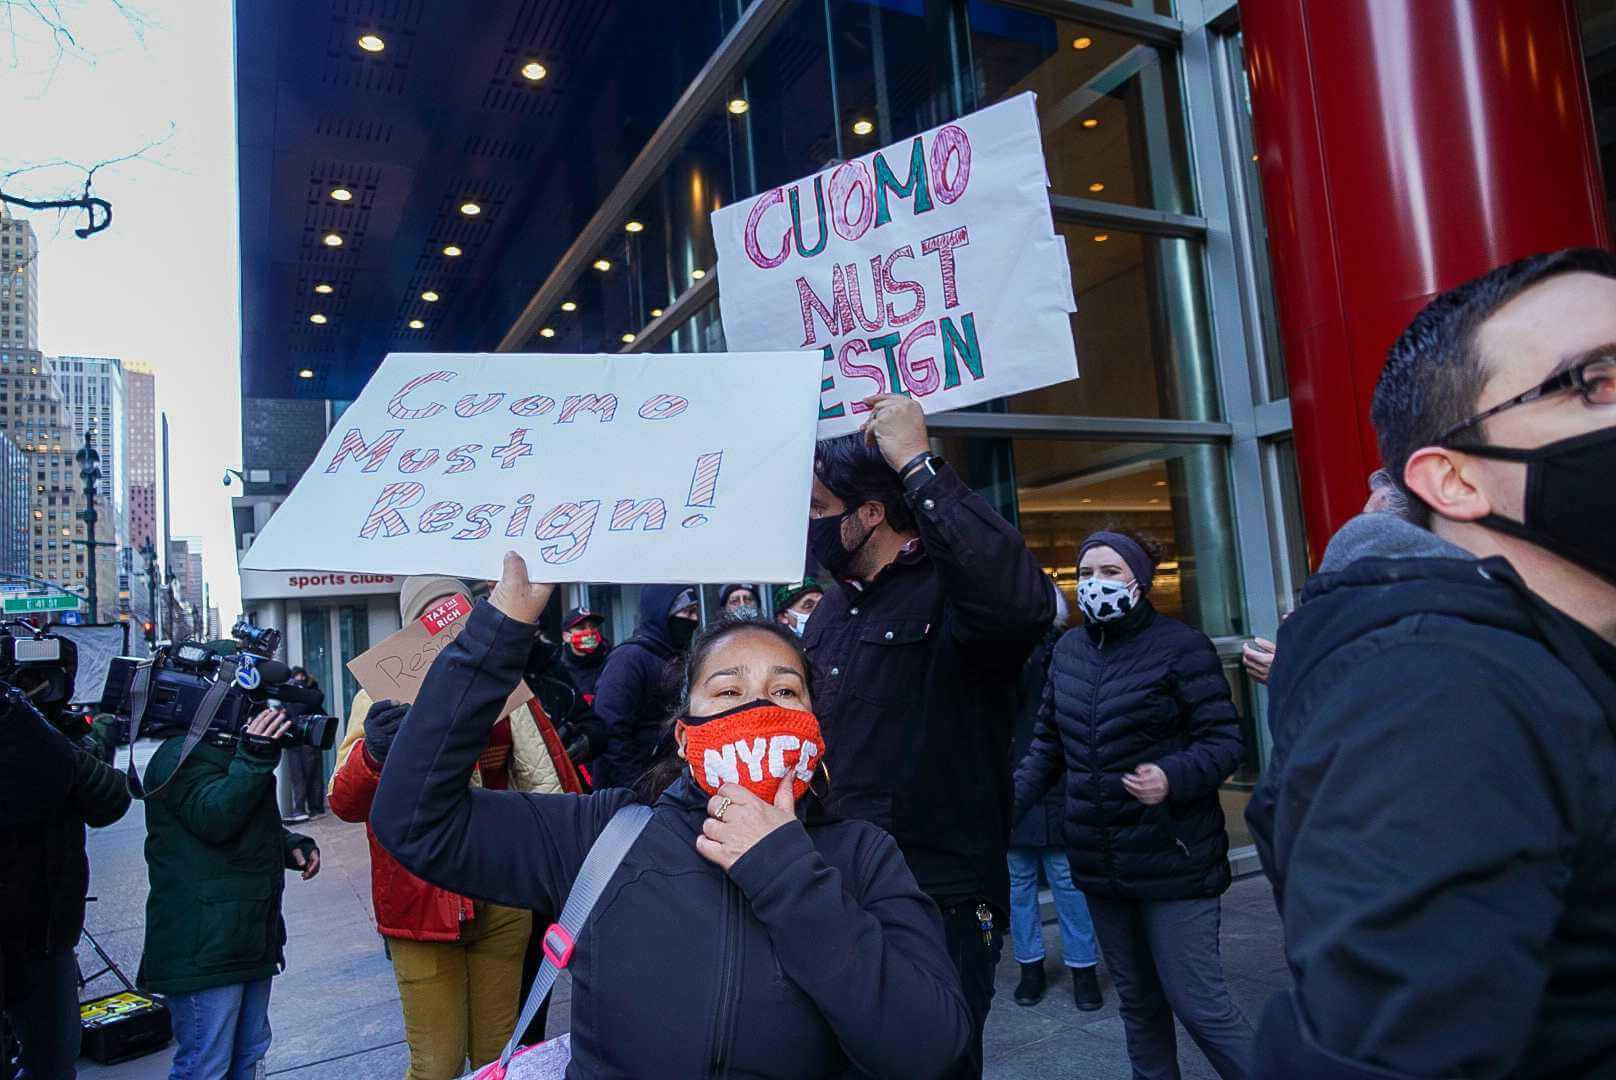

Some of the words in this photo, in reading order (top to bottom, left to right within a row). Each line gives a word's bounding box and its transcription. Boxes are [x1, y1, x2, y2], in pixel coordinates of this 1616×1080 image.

[744, 125, 972, 269] CUOMO
[796, 226, 969, 347] MUST
[817, 312, 985, 421] ESIGN
[387, 370, 690, 424] Cuomo
[323, 428, 535, 475] Must
[358, 449, 724, 565] Resign!
[289, 573, 345, 589] sports
[350, 574, 395, 584] clubs
[425, 606, 447, 622] TAX
[444, 598, 457, 609] THE
[436, 608, 461, 628] RICH
